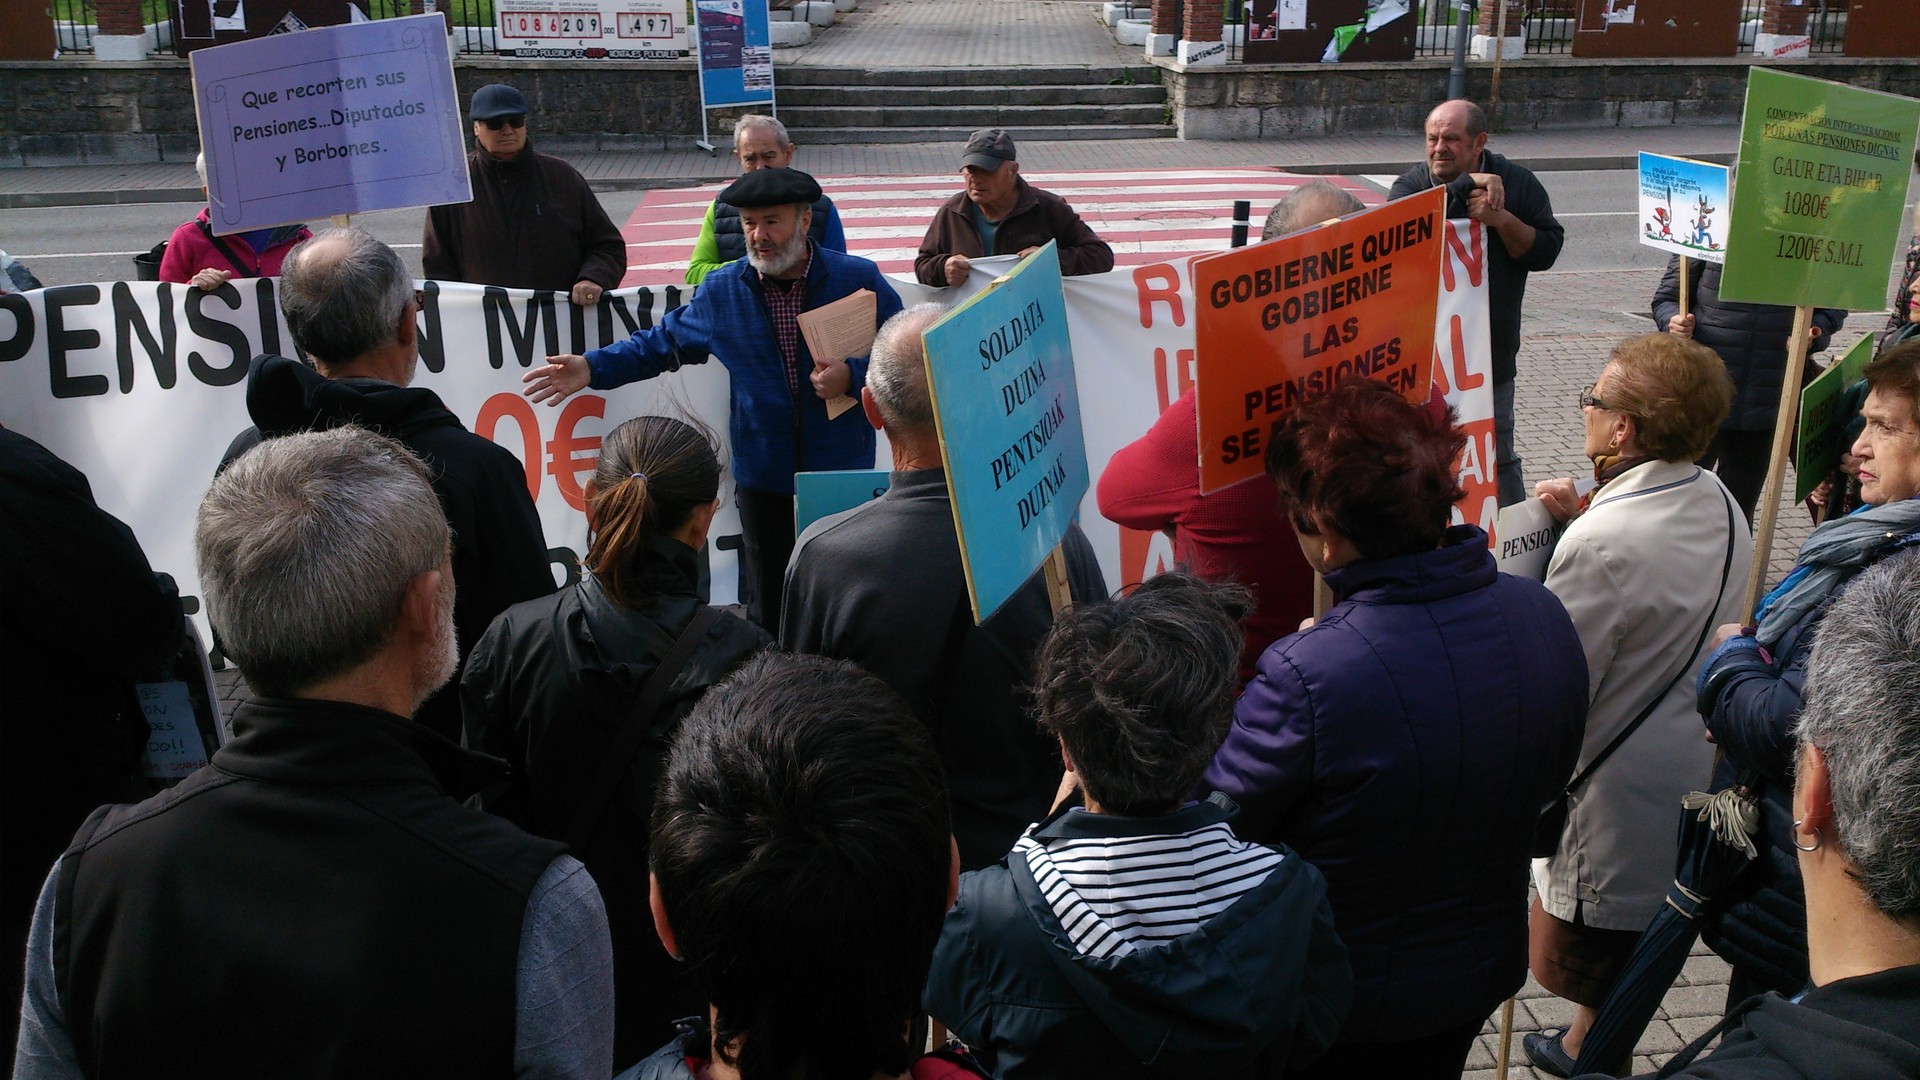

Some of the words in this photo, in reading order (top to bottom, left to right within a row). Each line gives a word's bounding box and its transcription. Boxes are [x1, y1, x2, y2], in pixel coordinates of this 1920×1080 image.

[241, 89, 278, 110] Que
[286, 75, 368, 100] recorten
[375, 70, 406, 87] sus
[1763, 122, 1785, 138] POR
[1788, 126, 1815, 143] UNAS
[1816, 131, 1866, 154] PENSIONES
[1867, 142, 1900, 161] DIGNAS
[1832, 119, 1901, 143] INTERGENERACIONAL
[275, 153, 287, 173] y
[295, 139, 388, 165] Borbones.
[1773, 156, 1817, 181] GAUR
[1817, 163, 1841, 185] ETA
[1844, 168, 1883, 191] BIHAR
[1783, 191, 1830, 219] 1080€
[1210, 242, 1354, 310] GOBIERNE
[1361, 213, 1434, 263] QUIEN
[1776, 234, 1824, 262] 1200€
[1825, 240, 1864, 267] S.M.I.
[1261, 262, 1393, 331] GOBIERNE
[0, 280, 445, 398] PENSIN
[978, 297, 1045, 372] SOLDATA
[1303, 316, 1359, 359] LAS
[1001, 357, 1046, 417] DUINA
[1244, 337, 1402, 421] PENSIONES
[990, 393, 1065, 491] PENTSIOAK
[1221, 430, 1261, 465] SE
[1016, 452, 1066, 531] DUINAK
